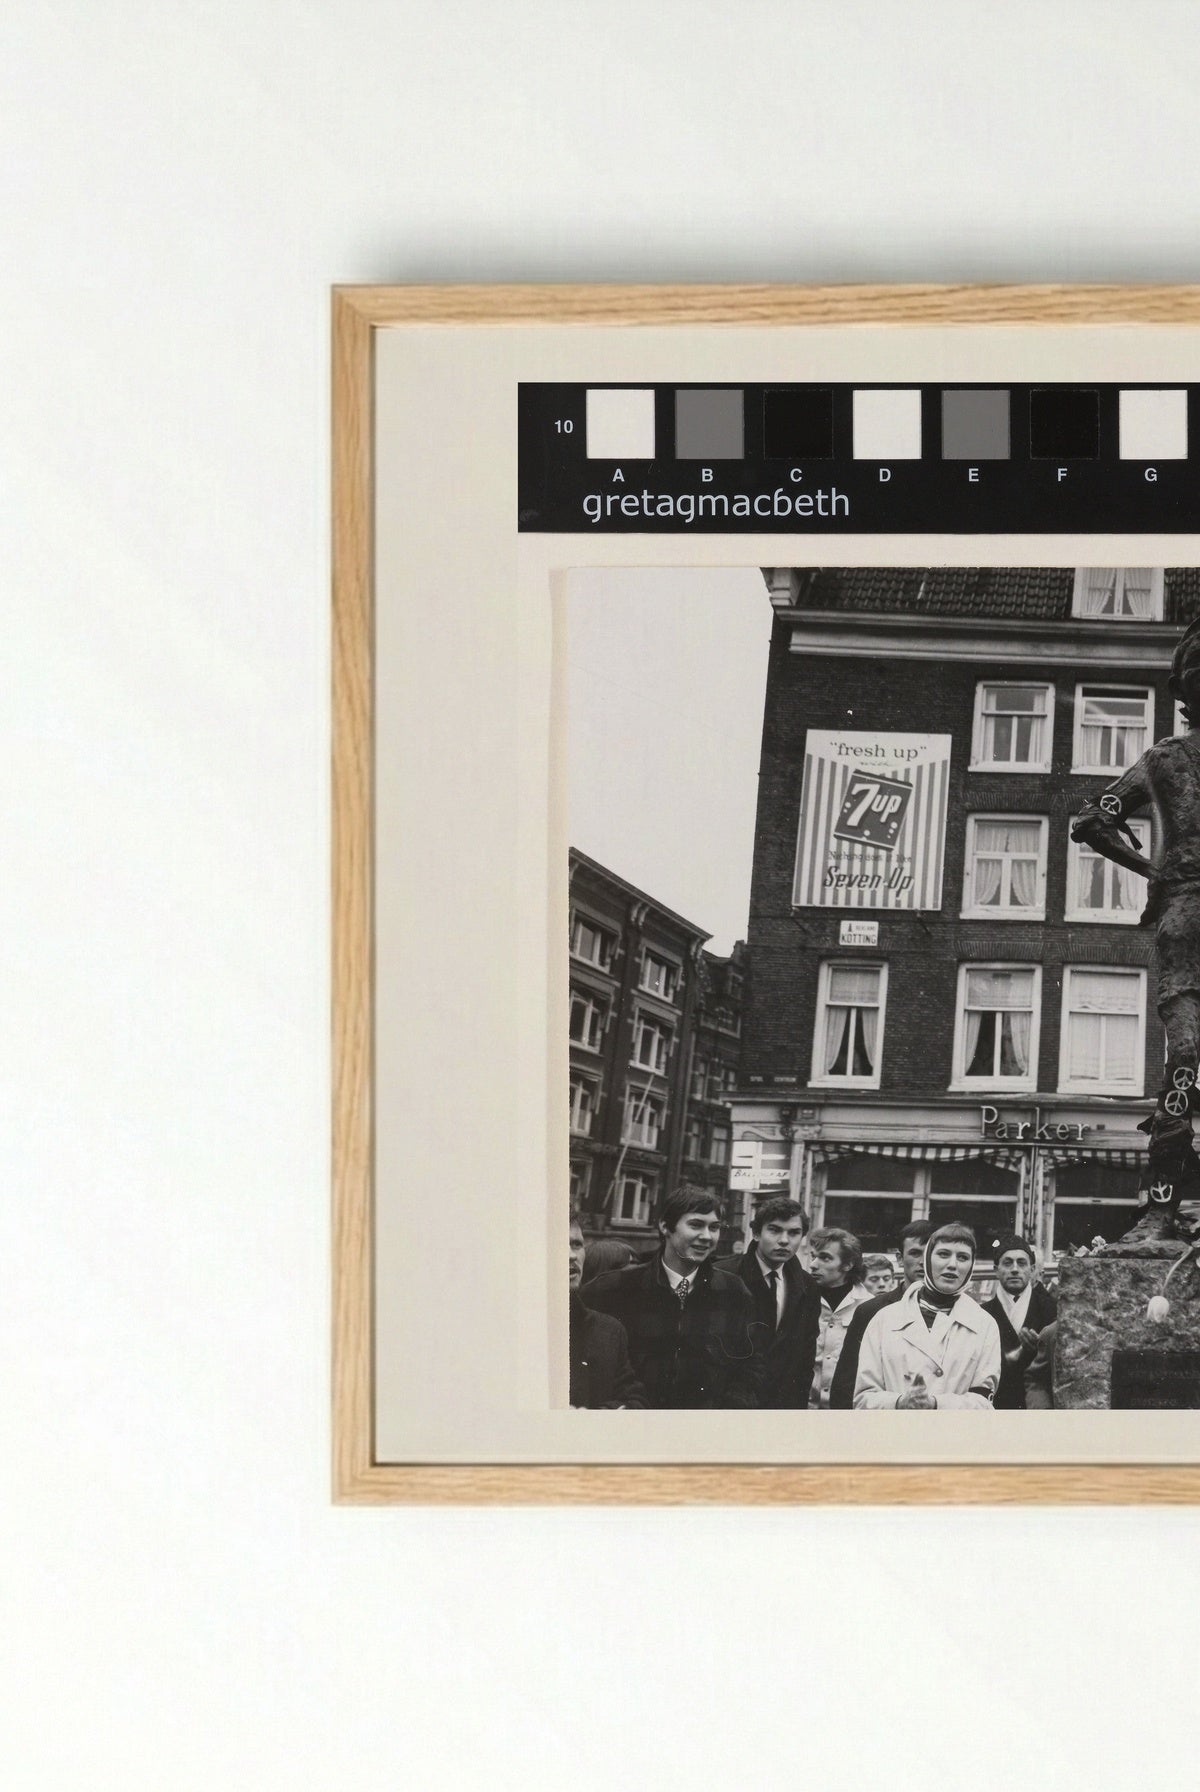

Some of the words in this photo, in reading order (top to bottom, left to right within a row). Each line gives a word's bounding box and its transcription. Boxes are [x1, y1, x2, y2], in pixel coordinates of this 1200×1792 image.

[554, 419, 574, 434] 10
[612, 468, 625, 482] A
[701, 468, 714, 482] B
[790, 468, 803, 483] C
[879, 468, 892, 482] D
[968, 468, 980, 482] E
[1057, 467, 1068, 482] F
[1144, 467, 1158, 482] G
[582, 487, 849, 523] gretagmacbeth
[980, 1105, 1090, 1141] Parker
